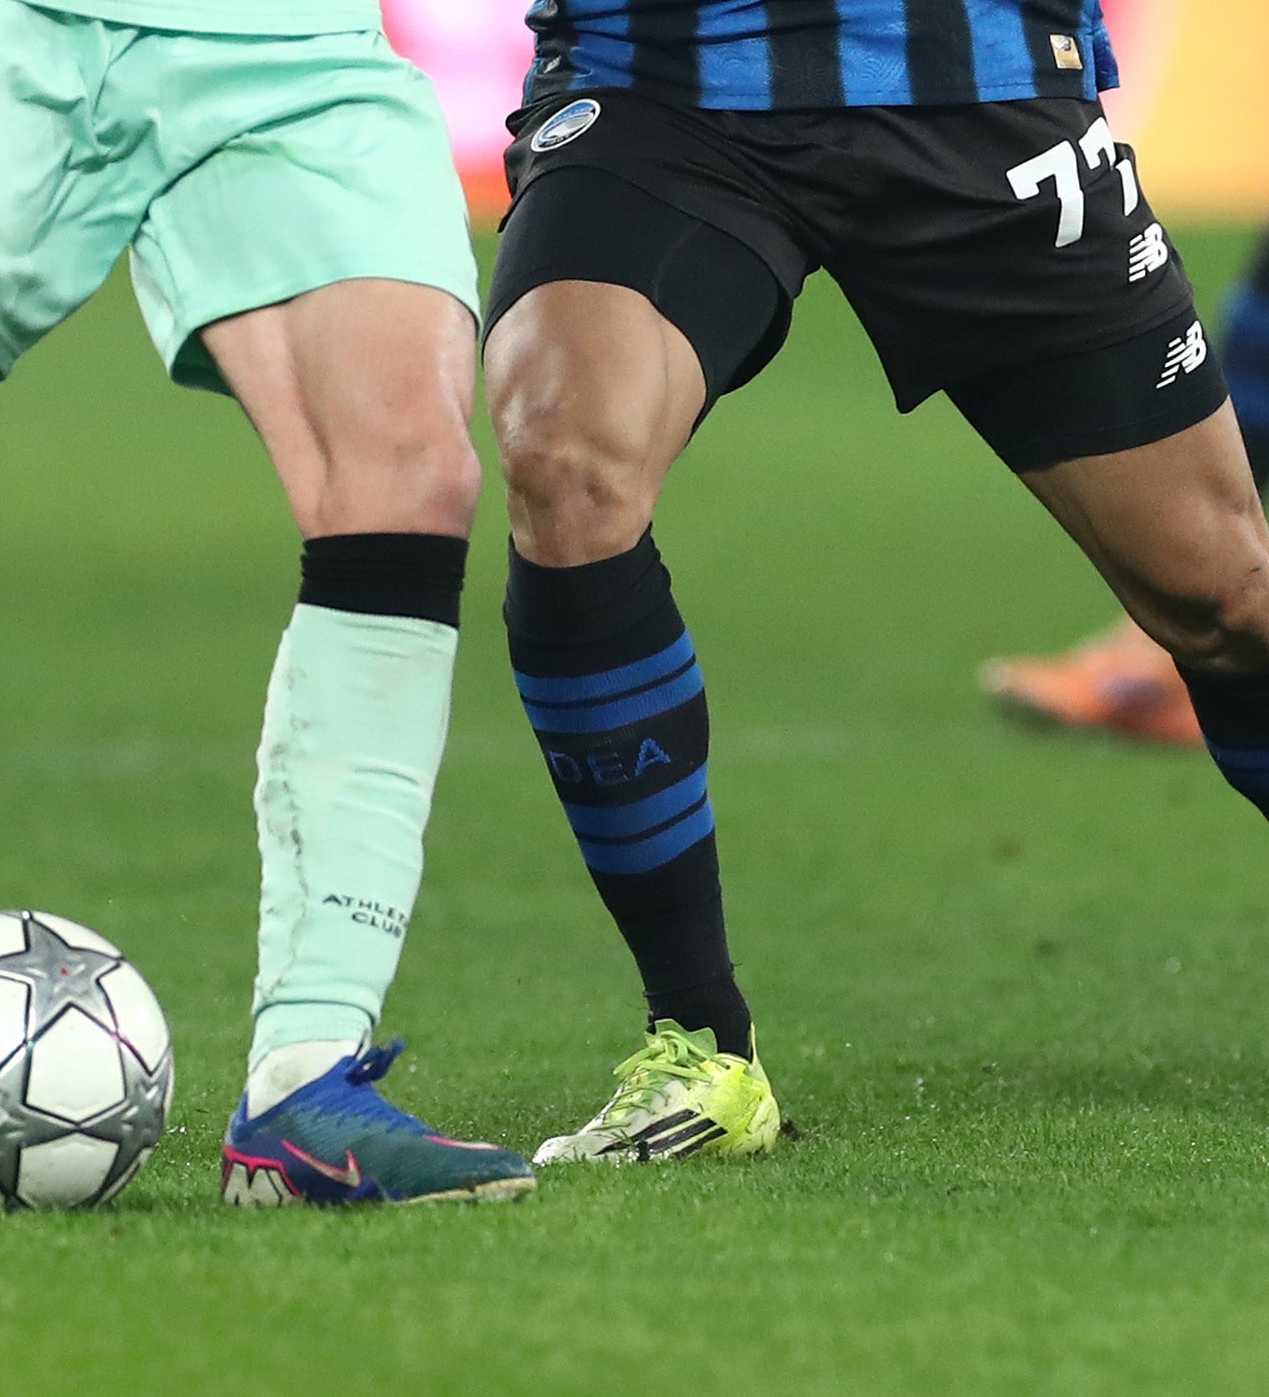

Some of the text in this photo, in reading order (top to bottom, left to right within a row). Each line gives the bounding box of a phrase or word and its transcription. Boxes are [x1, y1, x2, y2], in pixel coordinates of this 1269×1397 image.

[1006, 116, 1139, 248] 77
[549, 737, 671, 786] DEA
[322, 894, 410, 929] ATHLET
